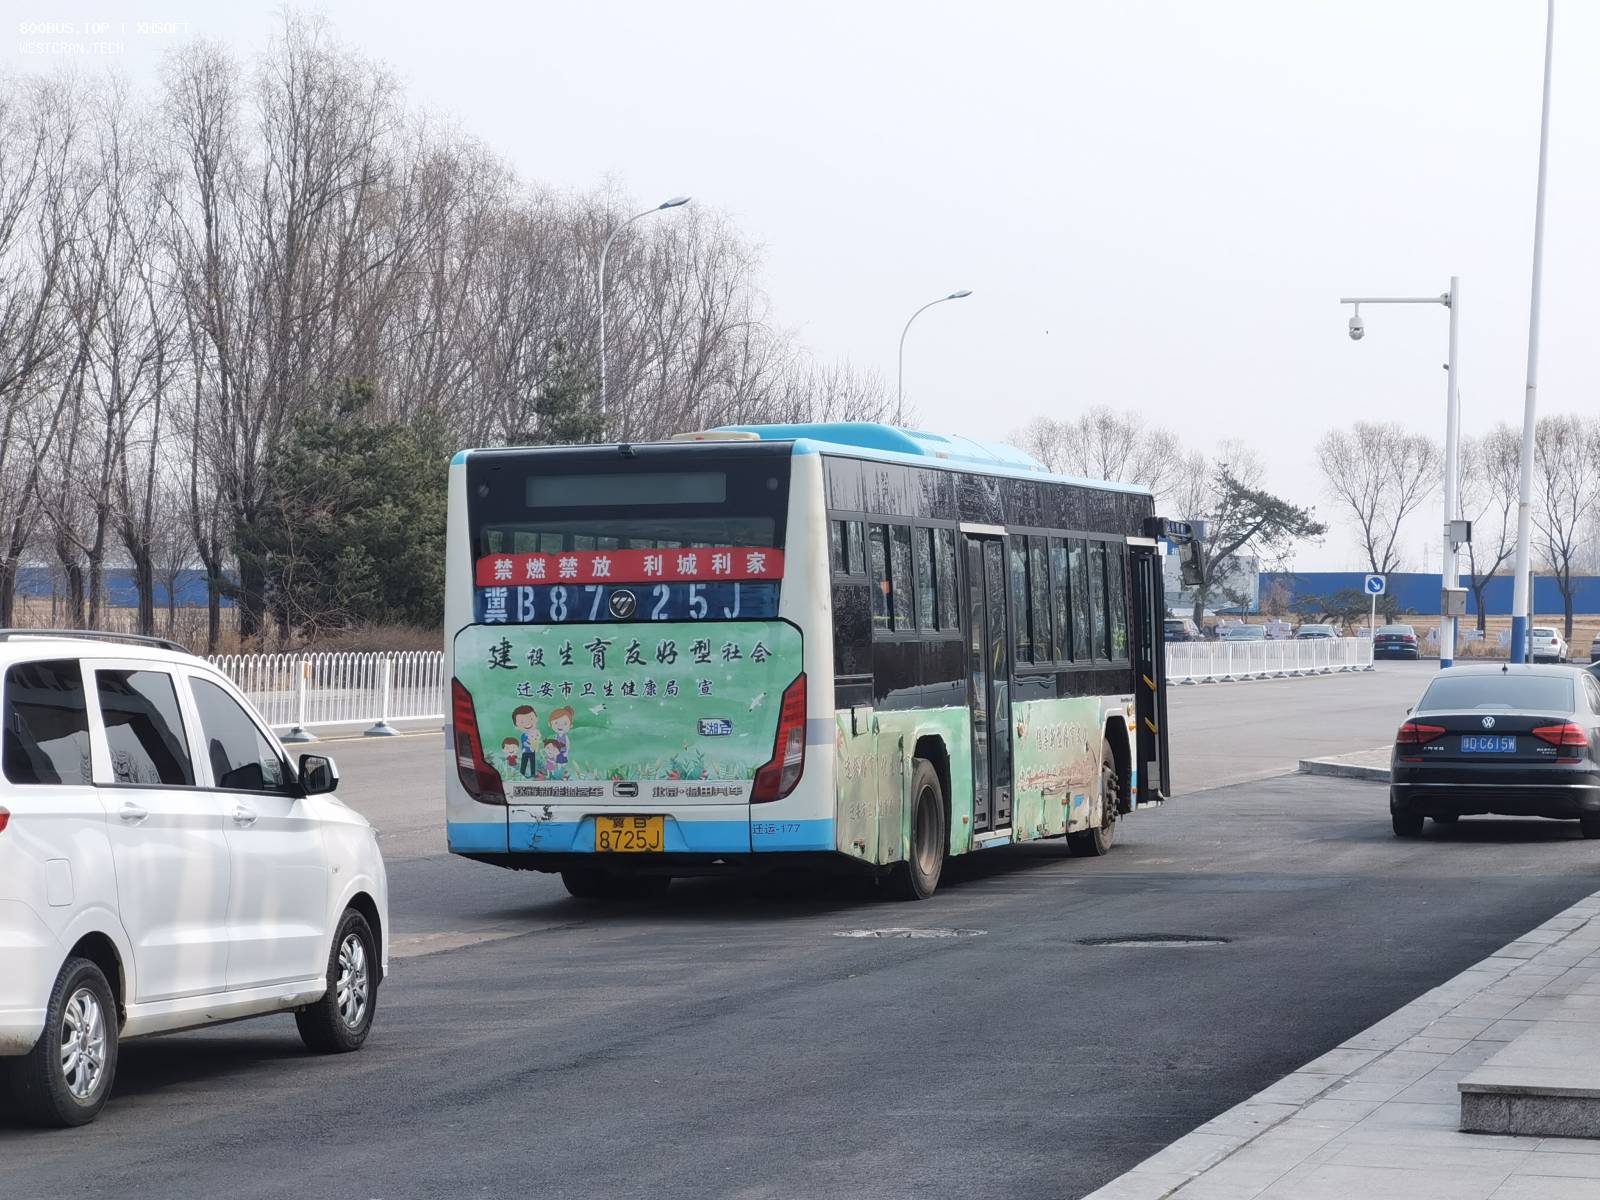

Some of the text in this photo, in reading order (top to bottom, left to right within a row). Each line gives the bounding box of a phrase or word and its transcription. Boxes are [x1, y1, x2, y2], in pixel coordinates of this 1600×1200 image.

[494, 552, 767, 580] 禁燃禁放 利城利家
[488, 637, 773, 671] 建设生育友好型社会
[516, 679, 713, 698] 迁安市卫生健康局 宣
[751, 823, 801, 835] 迁运-177
[599, 830, 660, 849] 8725J
